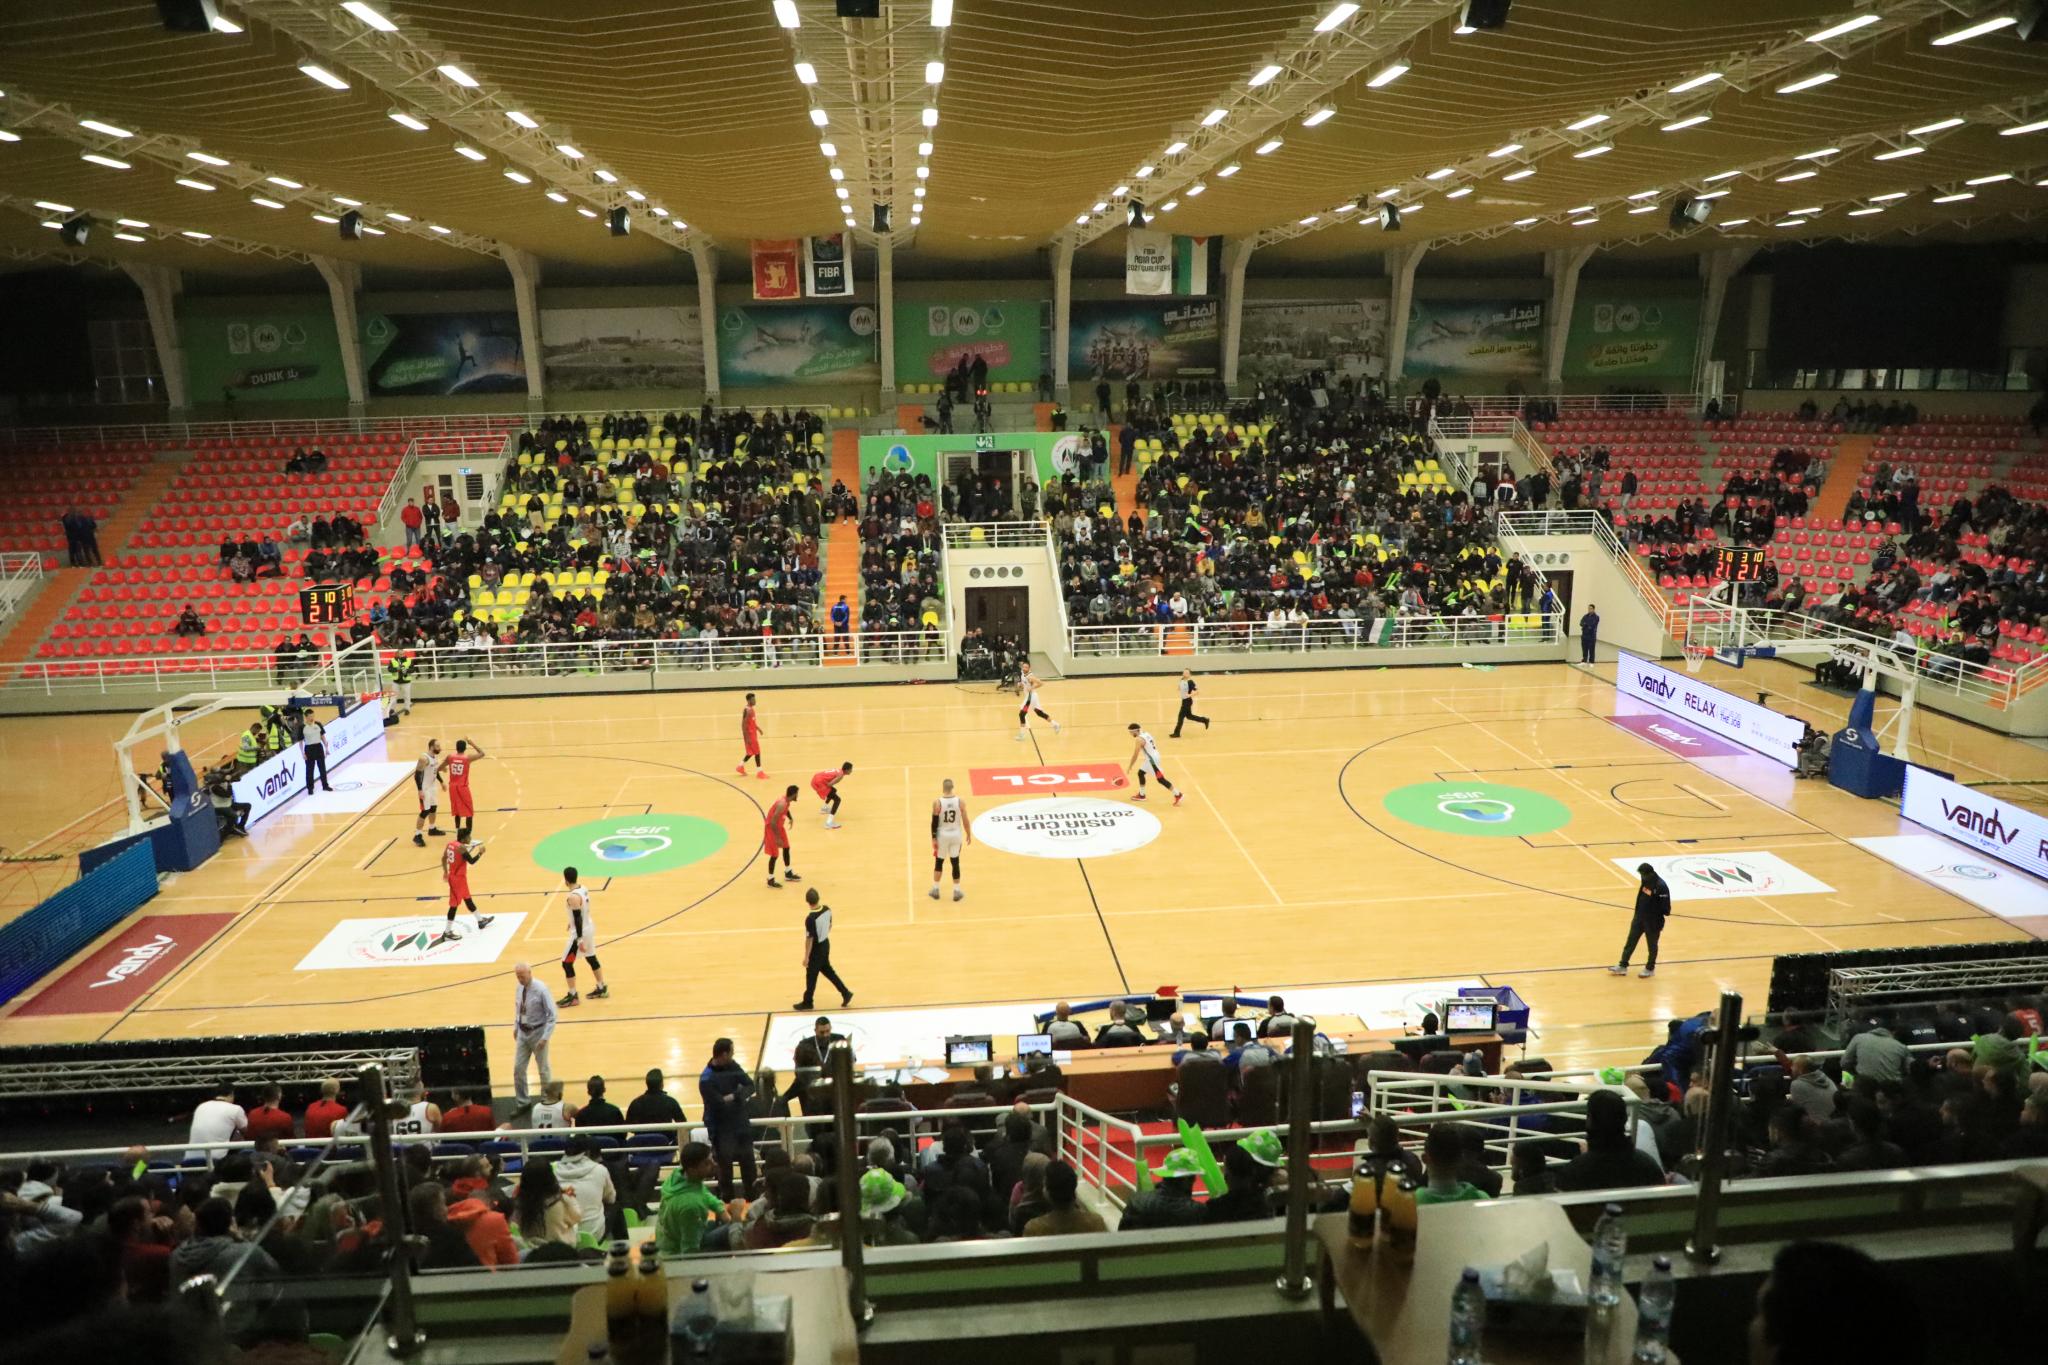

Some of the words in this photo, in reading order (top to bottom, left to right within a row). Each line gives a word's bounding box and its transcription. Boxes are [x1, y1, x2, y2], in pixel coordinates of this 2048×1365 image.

[1134, 255, 1150, 264] ASIA
[1151, 255, 1165, 264] CUP
[818, 266, 840, 278] FIBA
[1141, 264, 1171, 272] QUALIFIERS
[251, 370, 283, 384] DUNK
[1741, 552, 1748, 563] 3
[1753, 551, 1763, 562] 10
[1716, 561, 1730, 578] 21
[1738, 564, 1758, 580] 21
[310, 592, 317, 604] 3
[325, 591, 336, 603] 10
[310, 605, 332, 622] 21
[1684, 692, 1716, 718] RELAX
[1720, 713, 1730, 724] THE
[1730, 718, 1741, 729] JOB
[451, 763, 464, 776] 69
[992, 772, 1105, 786] TCL
[943, 810, 956, 823] 13
[991, 811, 1088, 822] QUALIFIERS
[1094, 810, 1135, 818] 2021
[1016, 820, 1060, 830] CUP
[1065, 819, 1116, 827] ASIA
[1049, 829, 1089, 837] FIBA
[396, 1120, 421, 1135] 69
